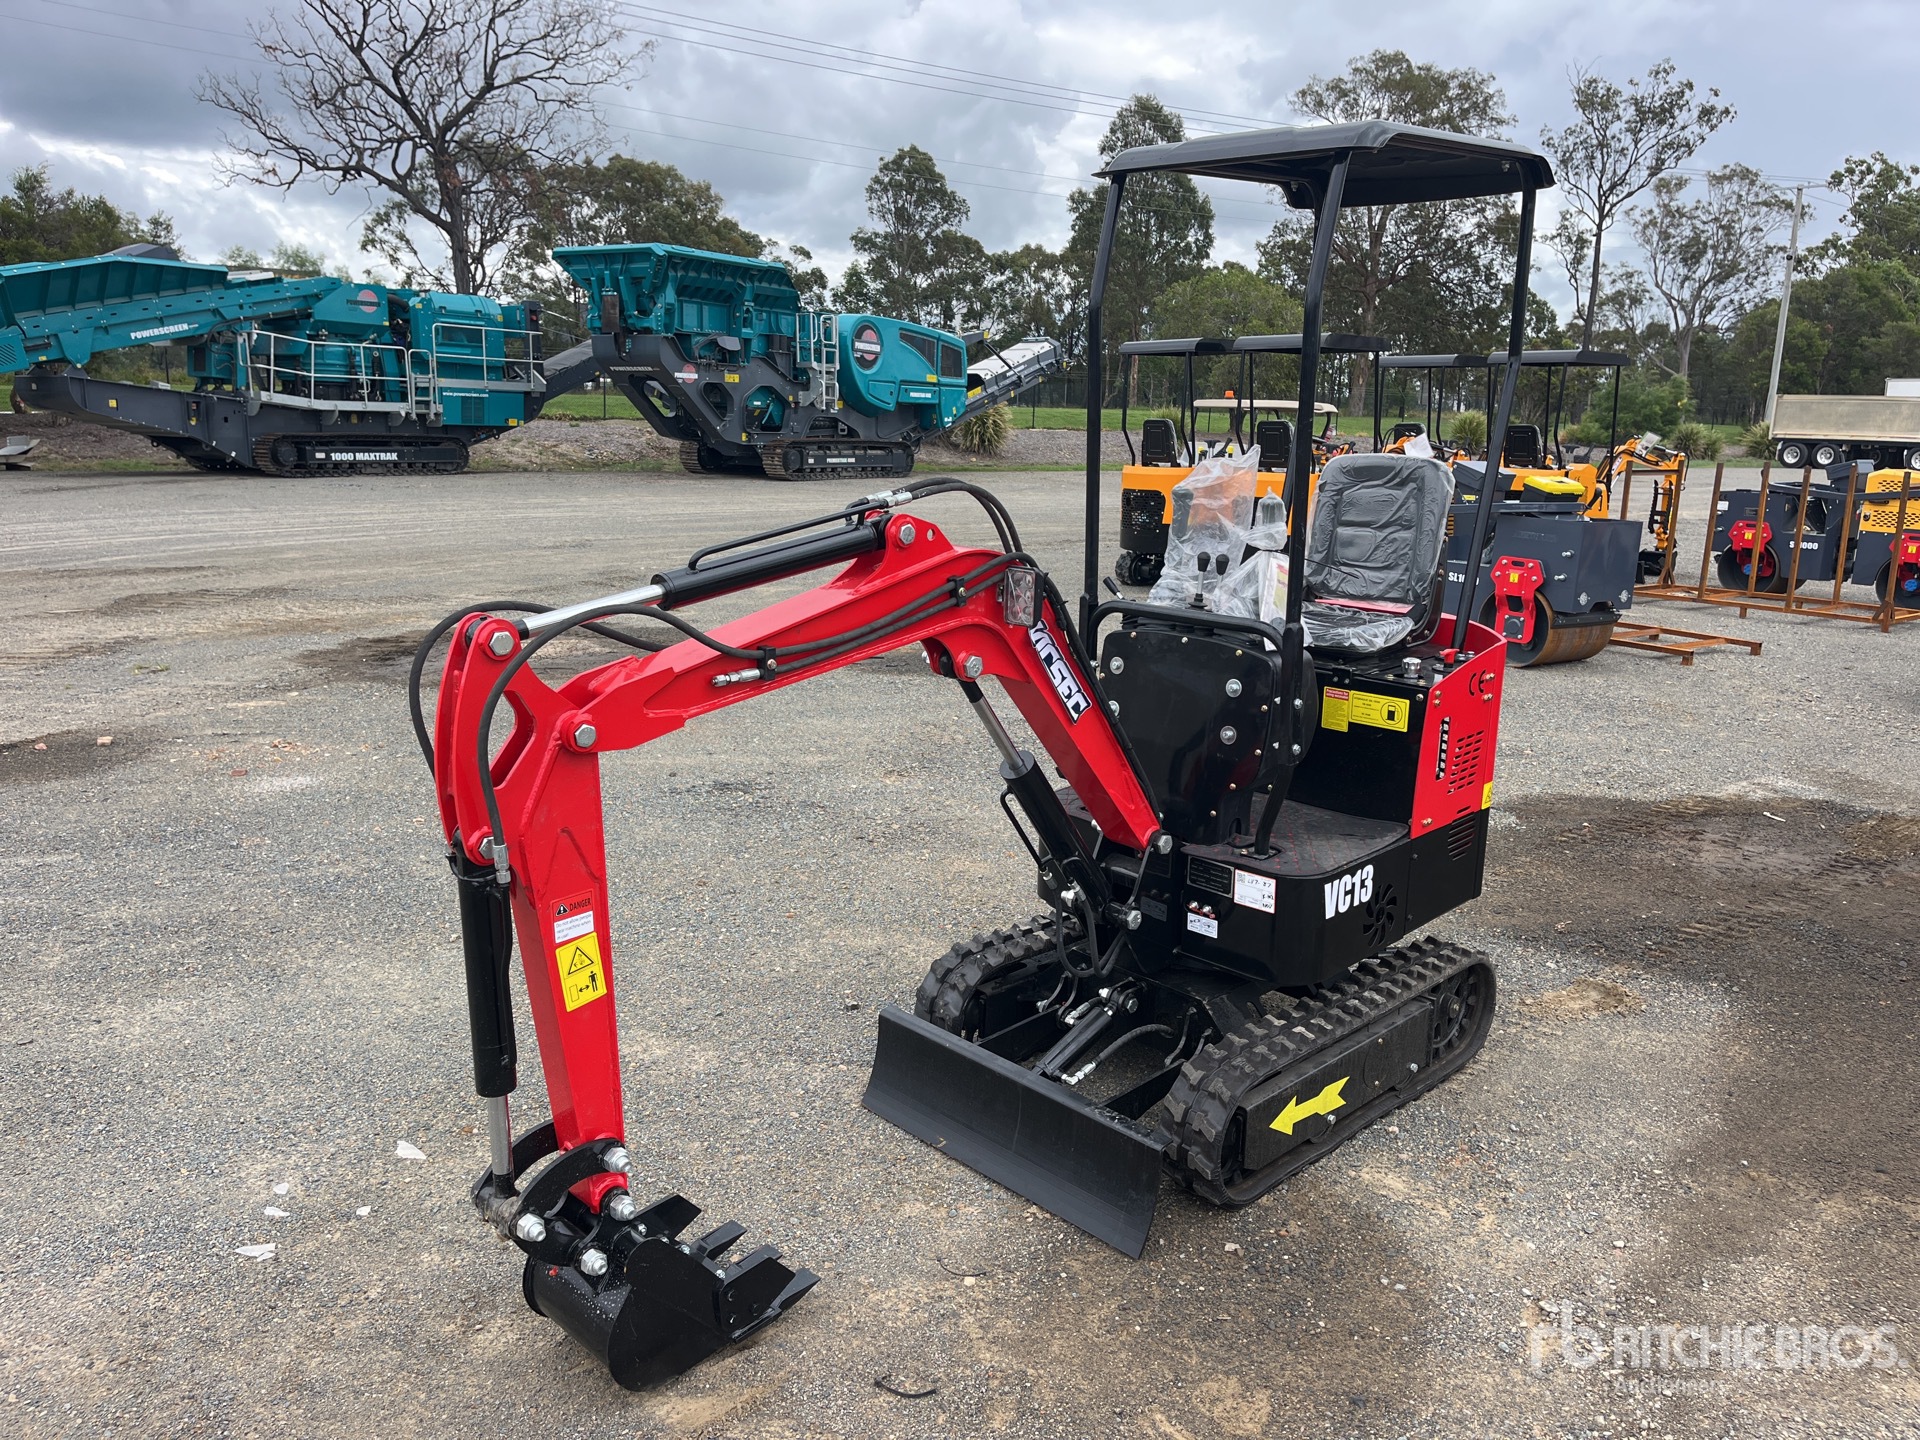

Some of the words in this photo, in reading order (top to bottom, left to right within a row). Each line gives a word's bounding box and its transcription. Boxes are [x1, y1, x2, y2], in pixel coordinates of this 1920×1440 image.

[130, 323, 189, 340] POWERSCREEN
[330, 452, 354, 461] 1000
[355, 452, 398, 461] MAXTRAK
[1324, 864, 1374, 920] VC13
[570, 898, 591, 911] DANGER
